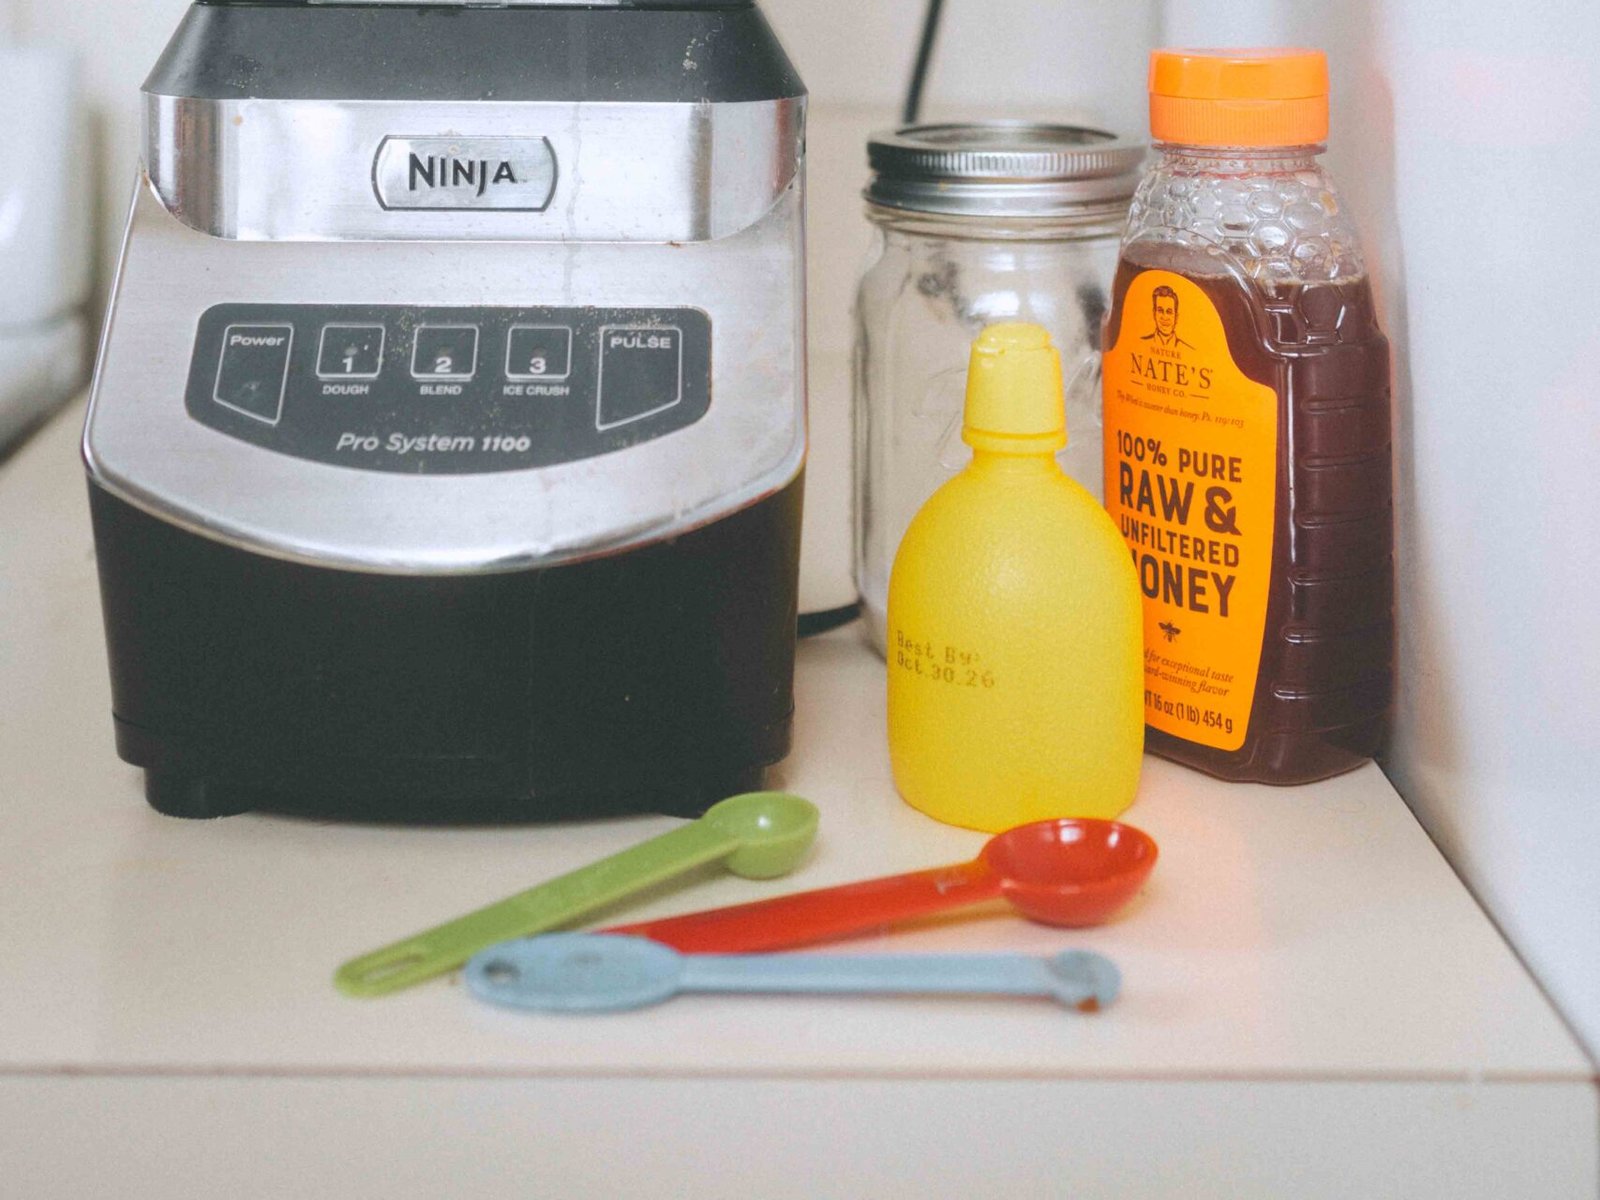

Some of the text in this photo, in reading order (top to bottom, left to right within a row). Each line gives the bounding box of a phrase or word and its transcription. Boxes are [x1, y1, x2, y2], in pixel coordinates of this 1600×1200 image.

[408, 152, 517, 198] NINJA
[229, 334, 285, 348] Power
[610, 335, 672, 349] PULSE
[1150, 347, 1182, 360] NATURE
[342, 357, 354, 373] 1
[434, 357, 451, 373] 2
[529, 357, 547, 374] 3
[1130, 352, 1211, 390] NATE'S
[322, 384, 369, 396] DOUGH
[419, 384, 462, 396] BLEND
[503, 384, 570, 397] ICE CRUSH
[336, 432, 532, 455] Pro System 1100
[1117, 429, 1242, 483] 100% PURE
[1119, 460, 1243, 536] RAW &
[1120, 513, 1239, 568] UNFILTERED
[1132, 549, 1236, 618] ONEY
[897, 630, 934, 659] Best
[1161, 657, 1211, 679] exceptional
[1211, 670, 1234, 683] taste
[1198, 680, 1230, 697] flavor
[1154, 693, 1162, 711] 16
[1163, 701, 1174, 716] oz
[1186, 705, 1200, 726] lb)
[1202, 710, 1222, 729] 454
[1225, 717, 1233, 734] g
